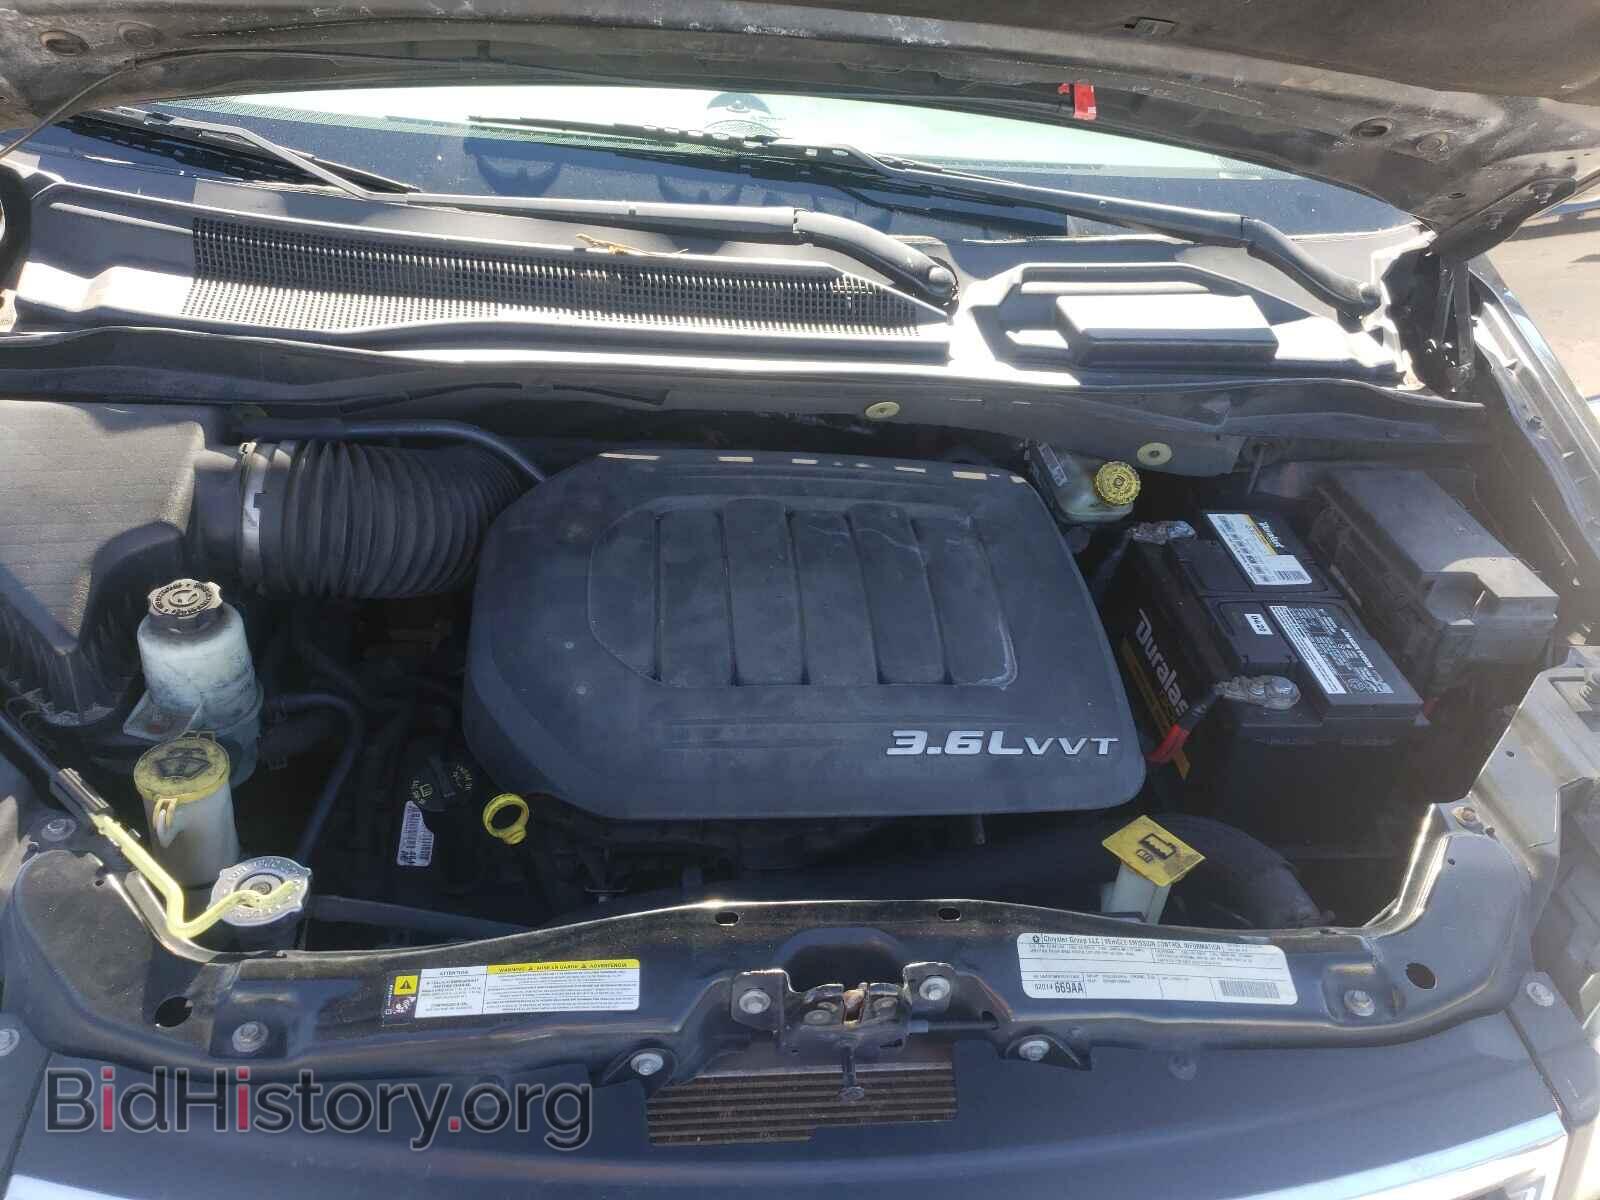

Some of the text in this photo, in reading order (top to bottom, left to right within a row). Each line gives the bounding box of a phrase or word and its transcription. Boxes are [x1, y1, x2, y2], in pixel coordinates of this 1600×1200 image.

[1135, 607, 1190, 718] Duralas
[886, 730, 1120, 755] 3.6L VVT
[1055, 981, 1084, 993] 669AA
